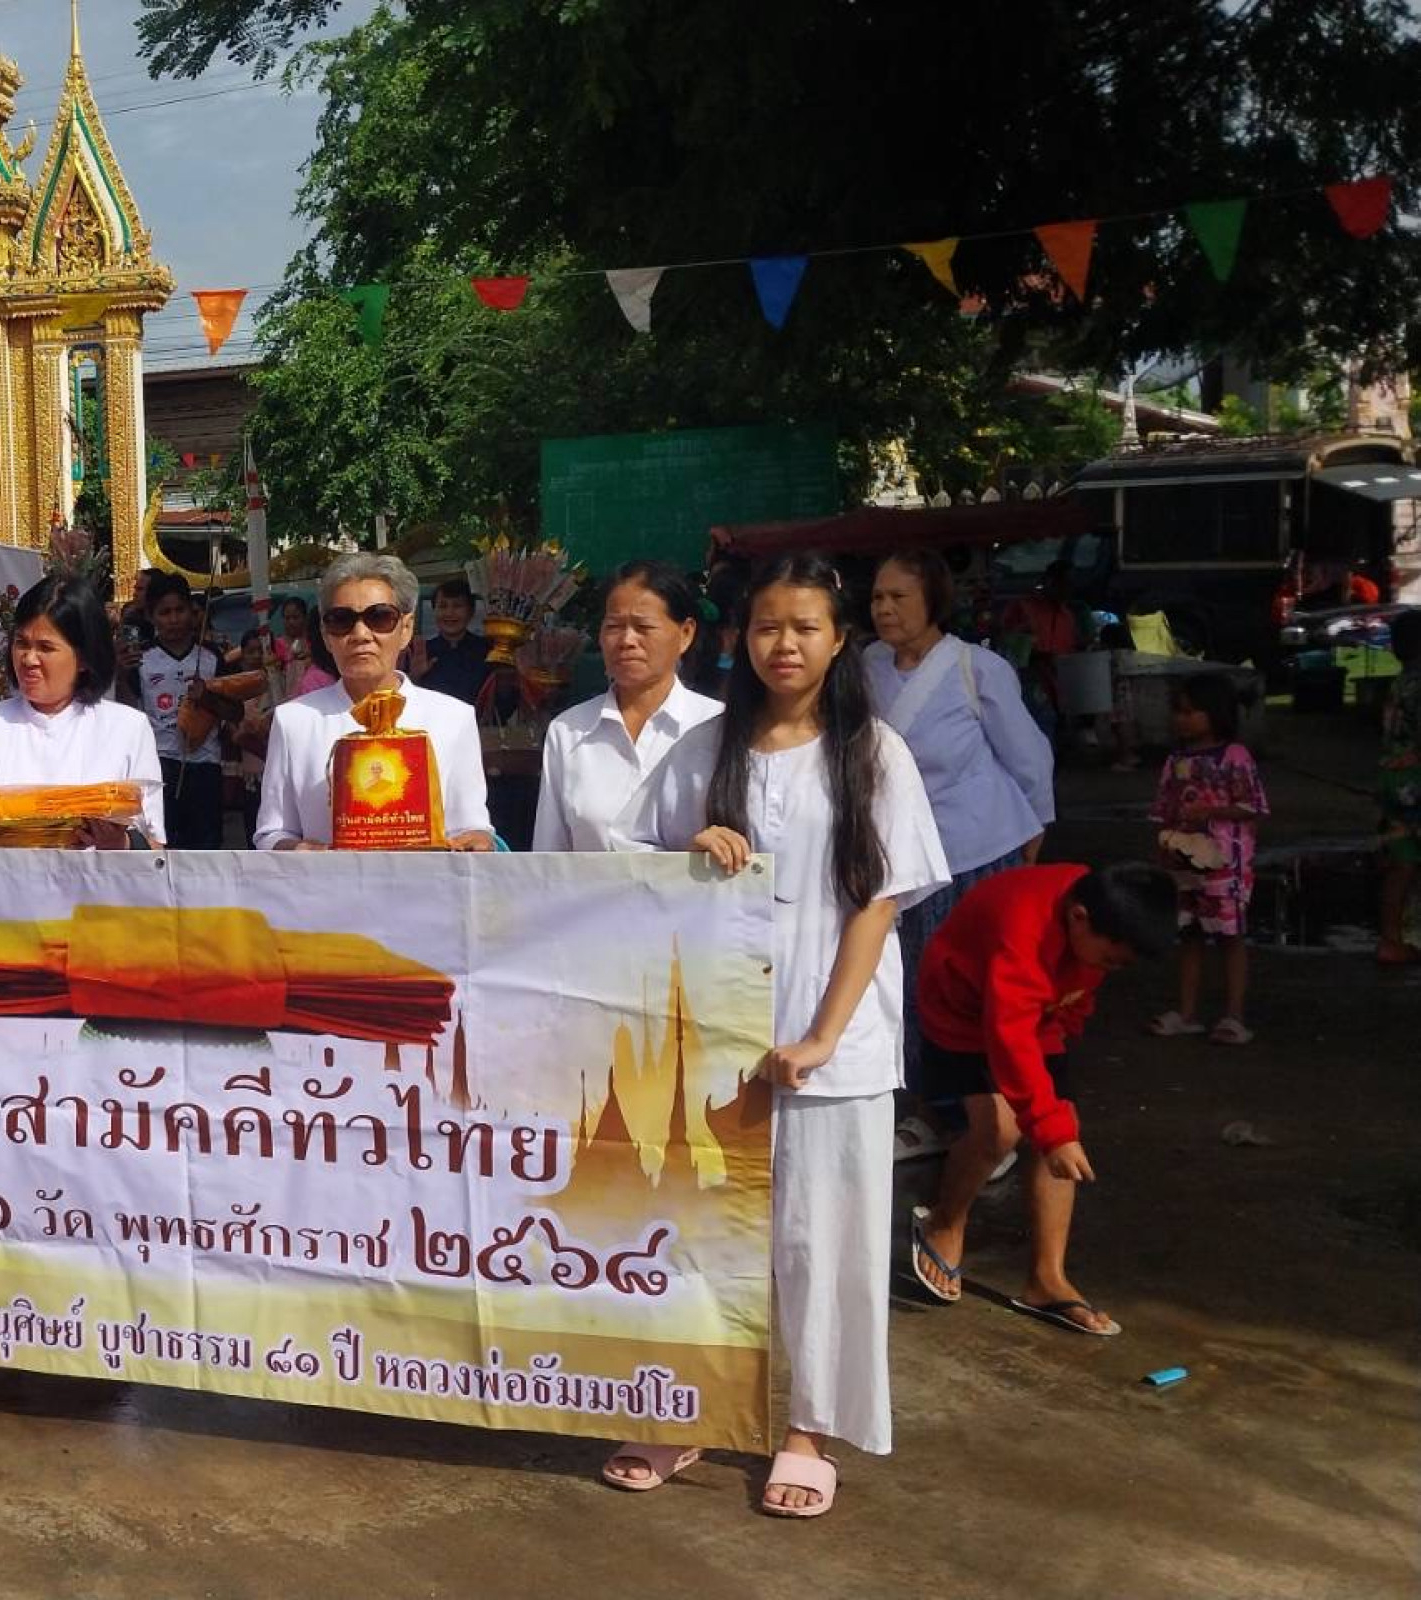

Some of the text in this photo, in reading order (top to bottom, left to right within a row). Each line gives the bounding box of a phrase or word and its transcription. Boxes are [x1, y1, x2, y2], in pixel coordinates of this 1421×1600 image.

[33, 1188, 94, 1239] วัด
[114, 1202, 390, 1268] พุทธศักราช
[410, 1206, 669, 1296] ๒๕๖๘
[97, 1313, 251, 1369] บูชาธรรม
[265, 1339, 320, 1376] ๘๑
[332, 1327, 360, 1381] ปี
[375, 1350, 695, 1419] หลวงพ่อธัมมชโย
